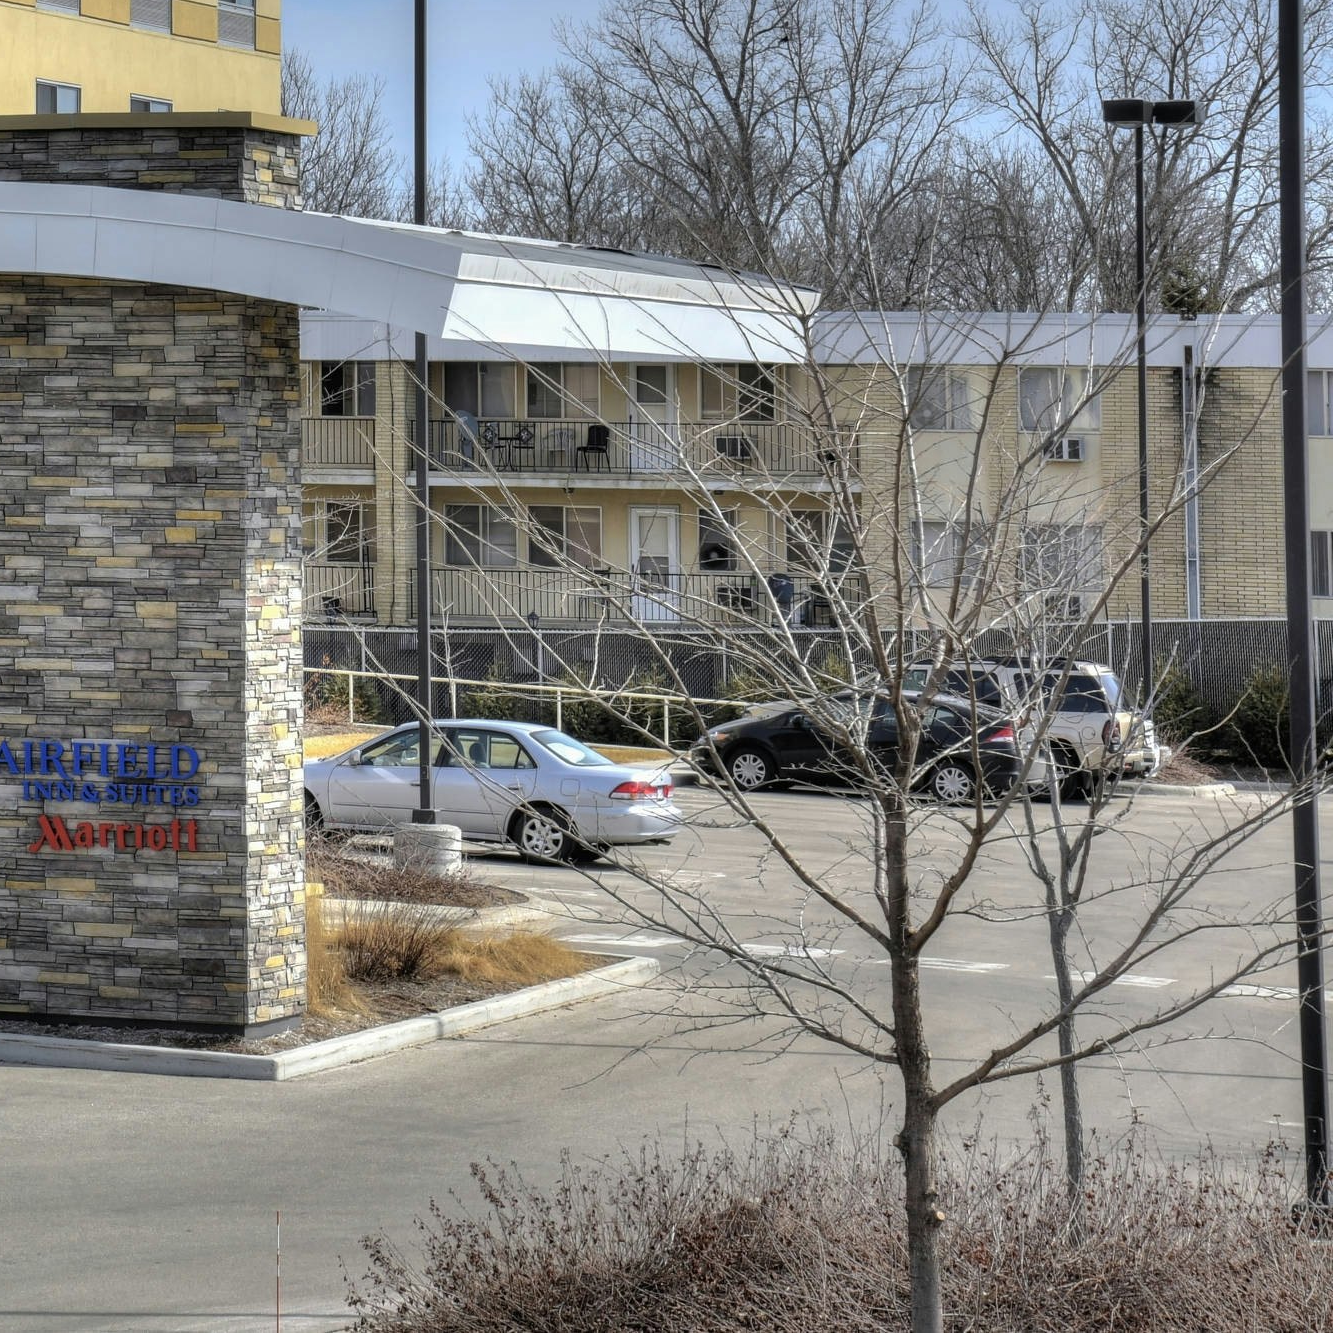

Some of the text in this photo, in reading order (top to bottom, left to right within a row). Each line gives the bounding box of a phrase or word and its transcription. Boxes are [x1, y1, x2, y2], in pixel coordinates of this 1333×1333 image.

[22, 780, 199, 806] INN & SUITES
[28, 814, 198, 853] Marriott
